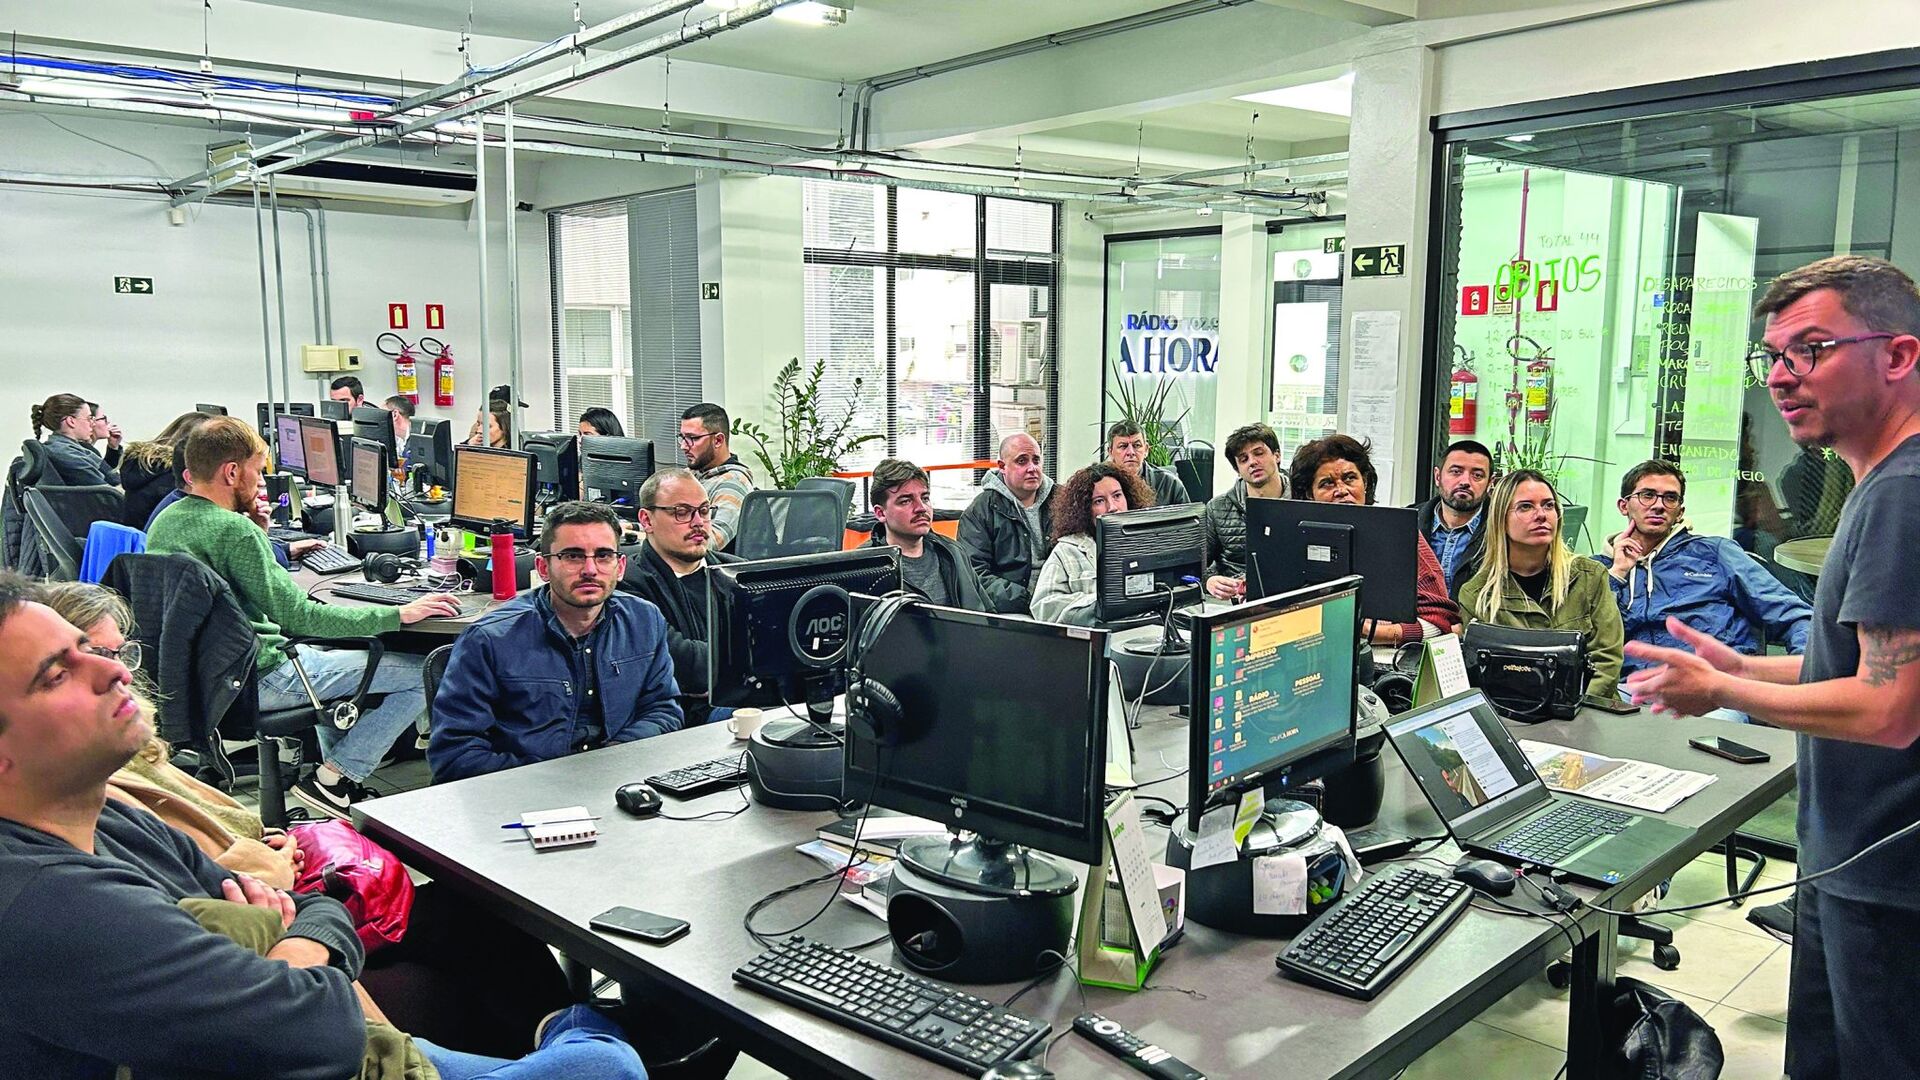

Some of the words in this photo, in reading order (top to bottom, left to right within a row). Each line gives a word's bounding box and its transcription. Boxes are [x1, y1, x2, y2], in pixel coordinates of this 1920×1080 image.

[1643, 276, 1758, 292] DESAPARECIDOS
[1127, 311, 1178, 331] RÁDIO
[1730, 470, 1765, 482] MEIO
[805, 615, 842, 635] AOC
[1294, 672, 1321, 687] PESSOAS
